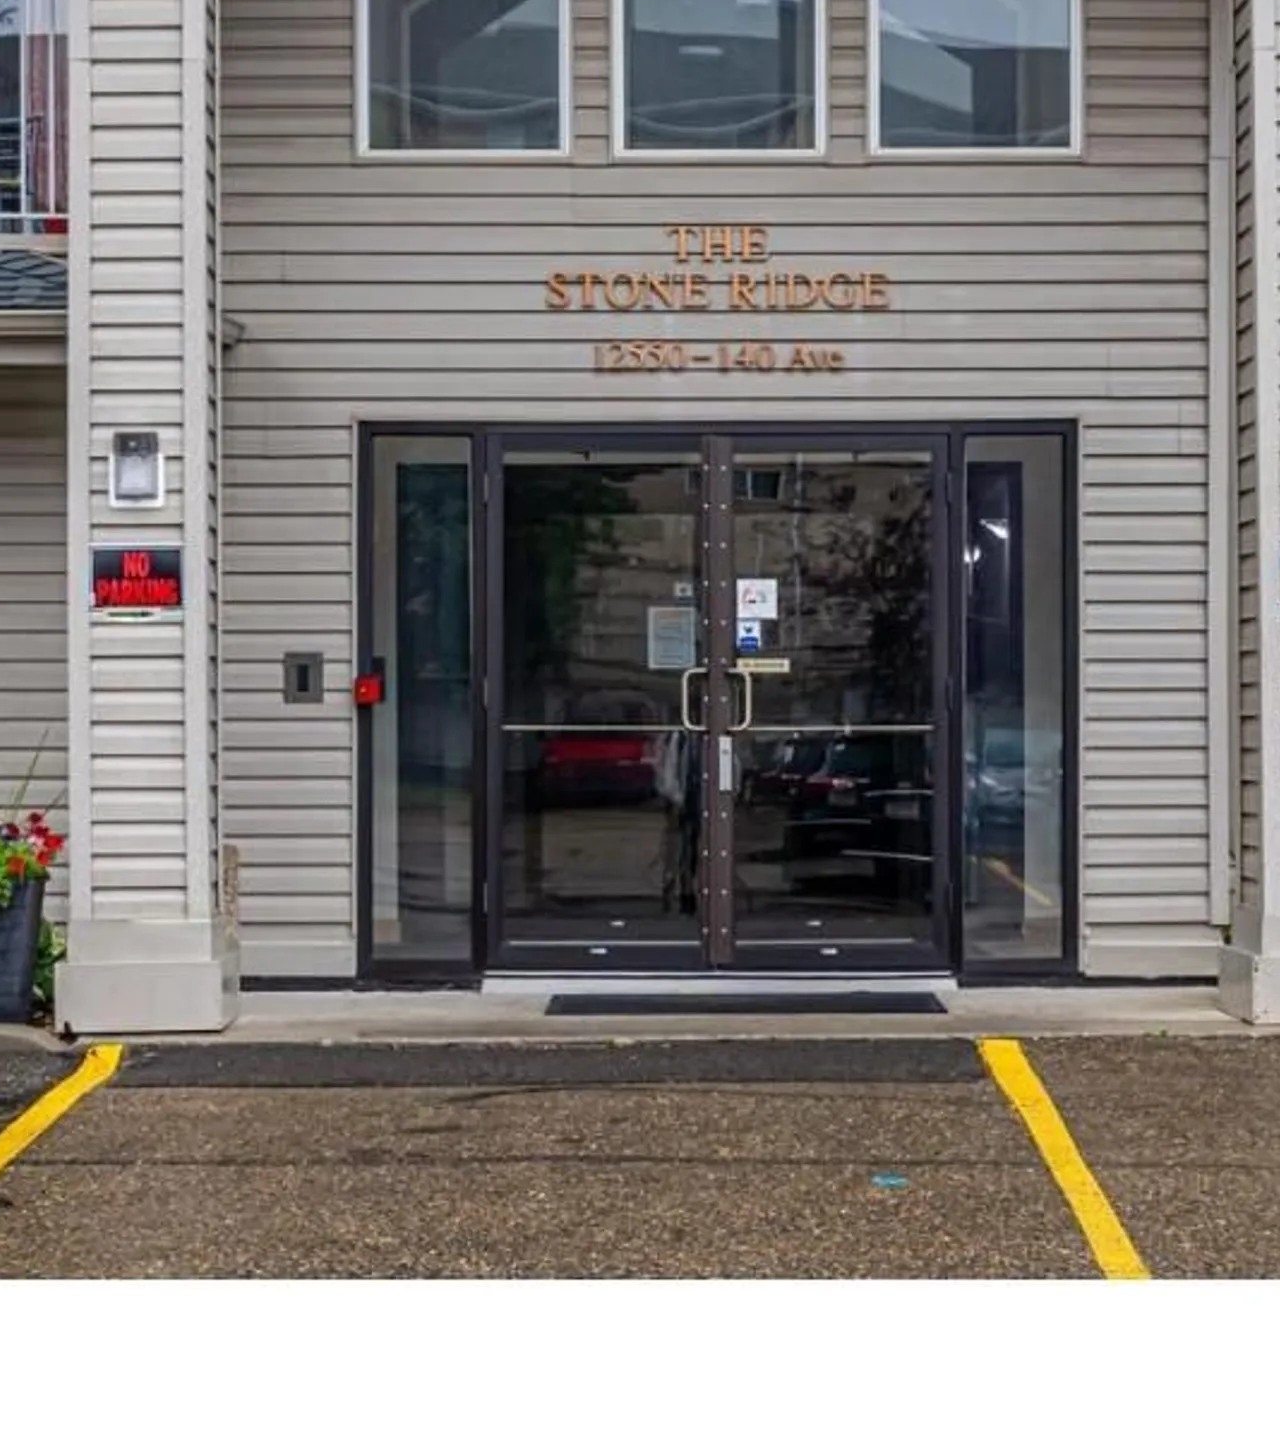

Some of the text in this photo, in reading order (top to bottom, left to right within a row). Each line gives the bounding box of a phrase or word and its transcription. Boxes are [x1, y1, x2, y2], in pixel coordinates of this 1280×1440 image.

[665, 226, 771, 263] THE
[545, 272, 892, 310] STONE RIDGE
[787, 342, 847, 372] Ave
[123, 551, 150, 578] NO
[95, 578, 179, 607] PARKING
